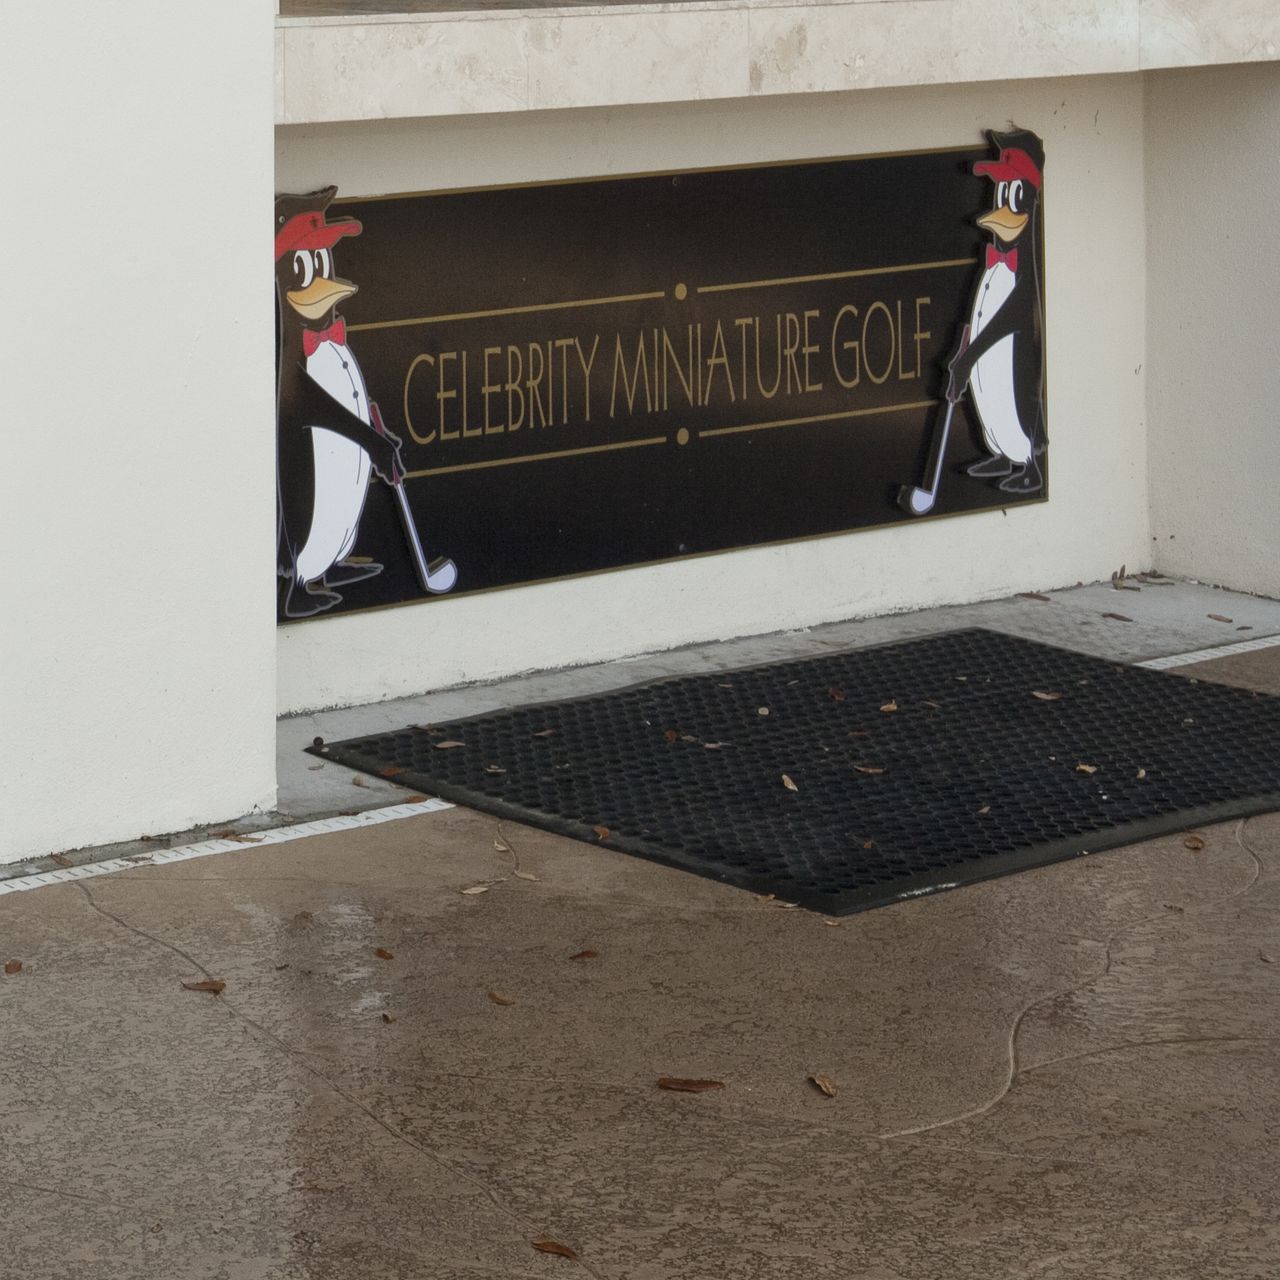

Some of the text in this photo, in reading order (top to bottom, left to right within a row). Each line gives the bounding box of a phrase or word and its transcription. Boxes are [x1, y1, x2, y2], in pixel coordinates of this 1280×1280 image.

[403, 296, 931, 446] CELEBRITY MINIATURE GOLF
